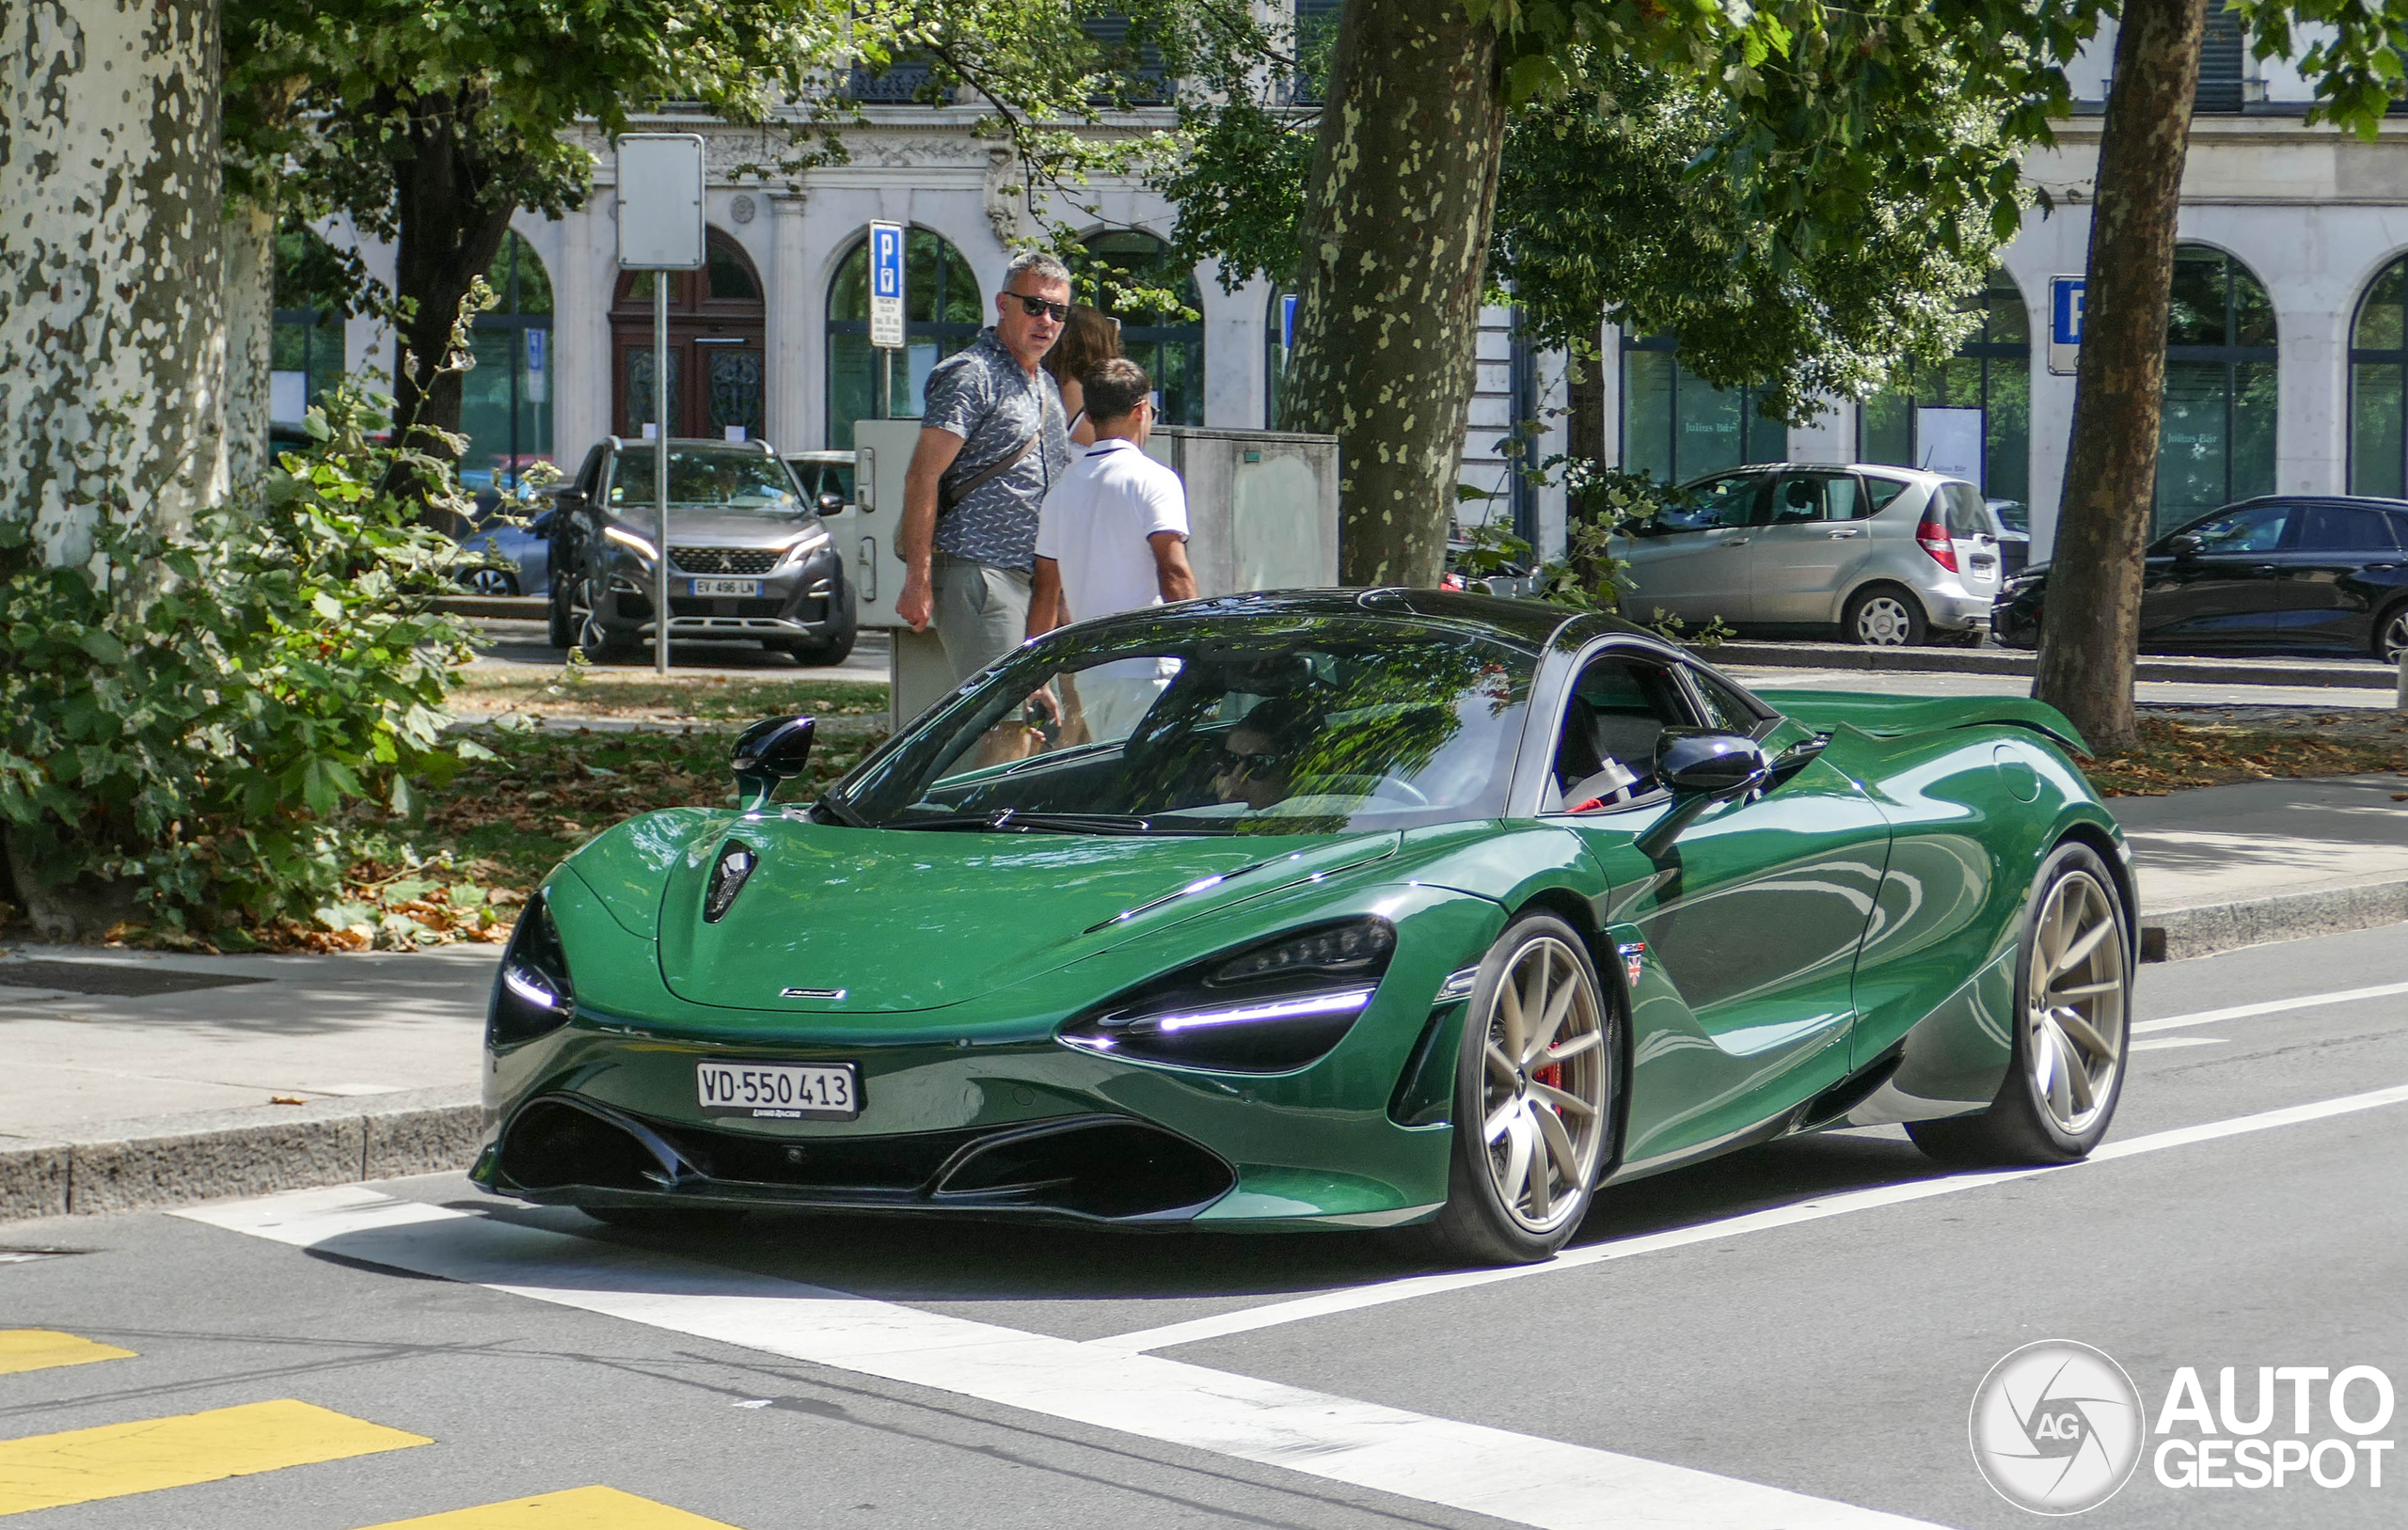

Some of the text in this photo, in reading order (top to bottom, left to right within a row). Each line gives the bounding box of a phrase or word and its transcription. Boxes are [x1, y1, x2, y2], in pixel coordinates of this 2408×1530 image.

[880, 234, 893, 266] P
[1686, 422, 1713, 433] Julius
[2167, 434, 2195, 443] Julius
